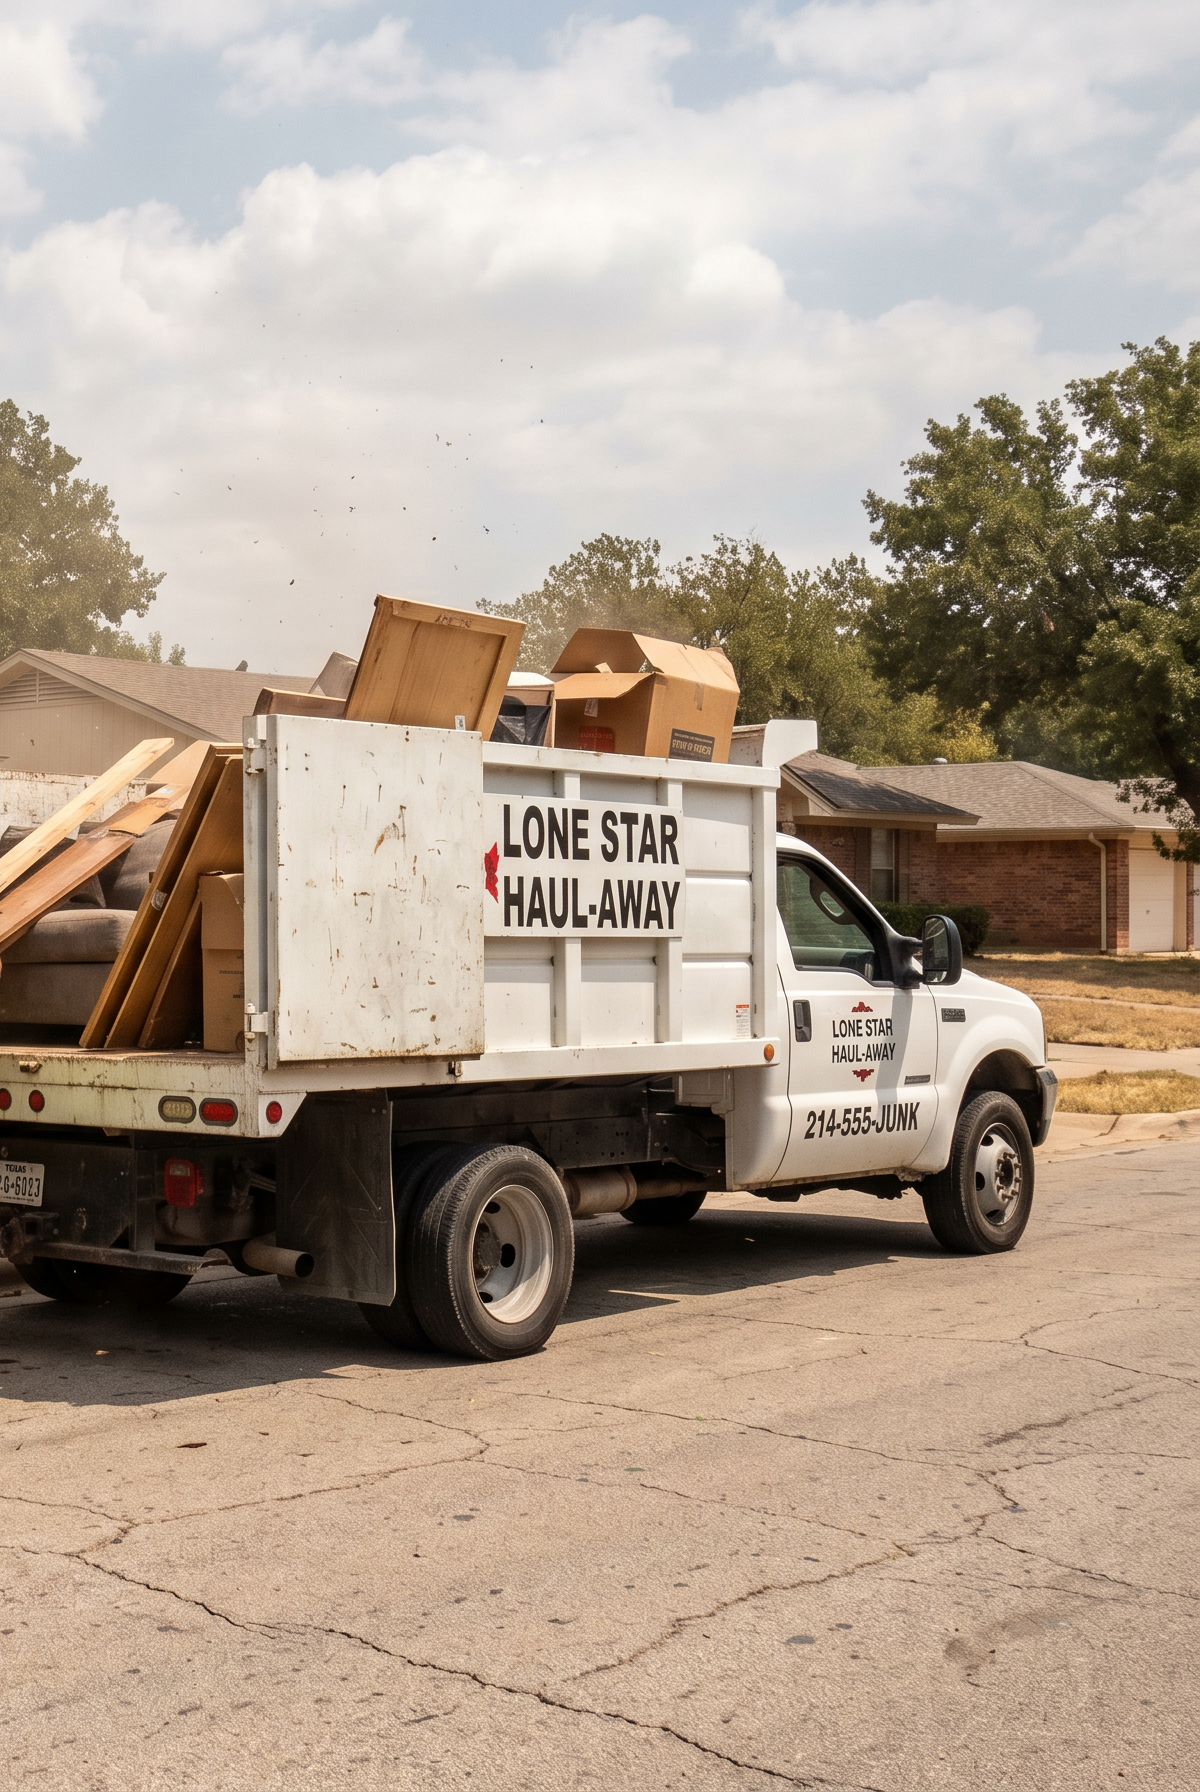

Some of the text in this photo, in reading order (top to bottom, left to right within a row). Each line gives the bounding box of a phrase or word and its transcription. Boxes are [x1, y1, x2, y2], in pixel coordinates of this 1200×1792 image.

[503, 804, 680, 865] LONE STAR
[503, 875, 681, 929] HAUL-AWAY
[832, 1018, 893, 1038] LONE STAR
[831, 1043, 896, 1063] HAUL-AWAY
[804, 1102, 920, 1139] 214-555-JUNK
